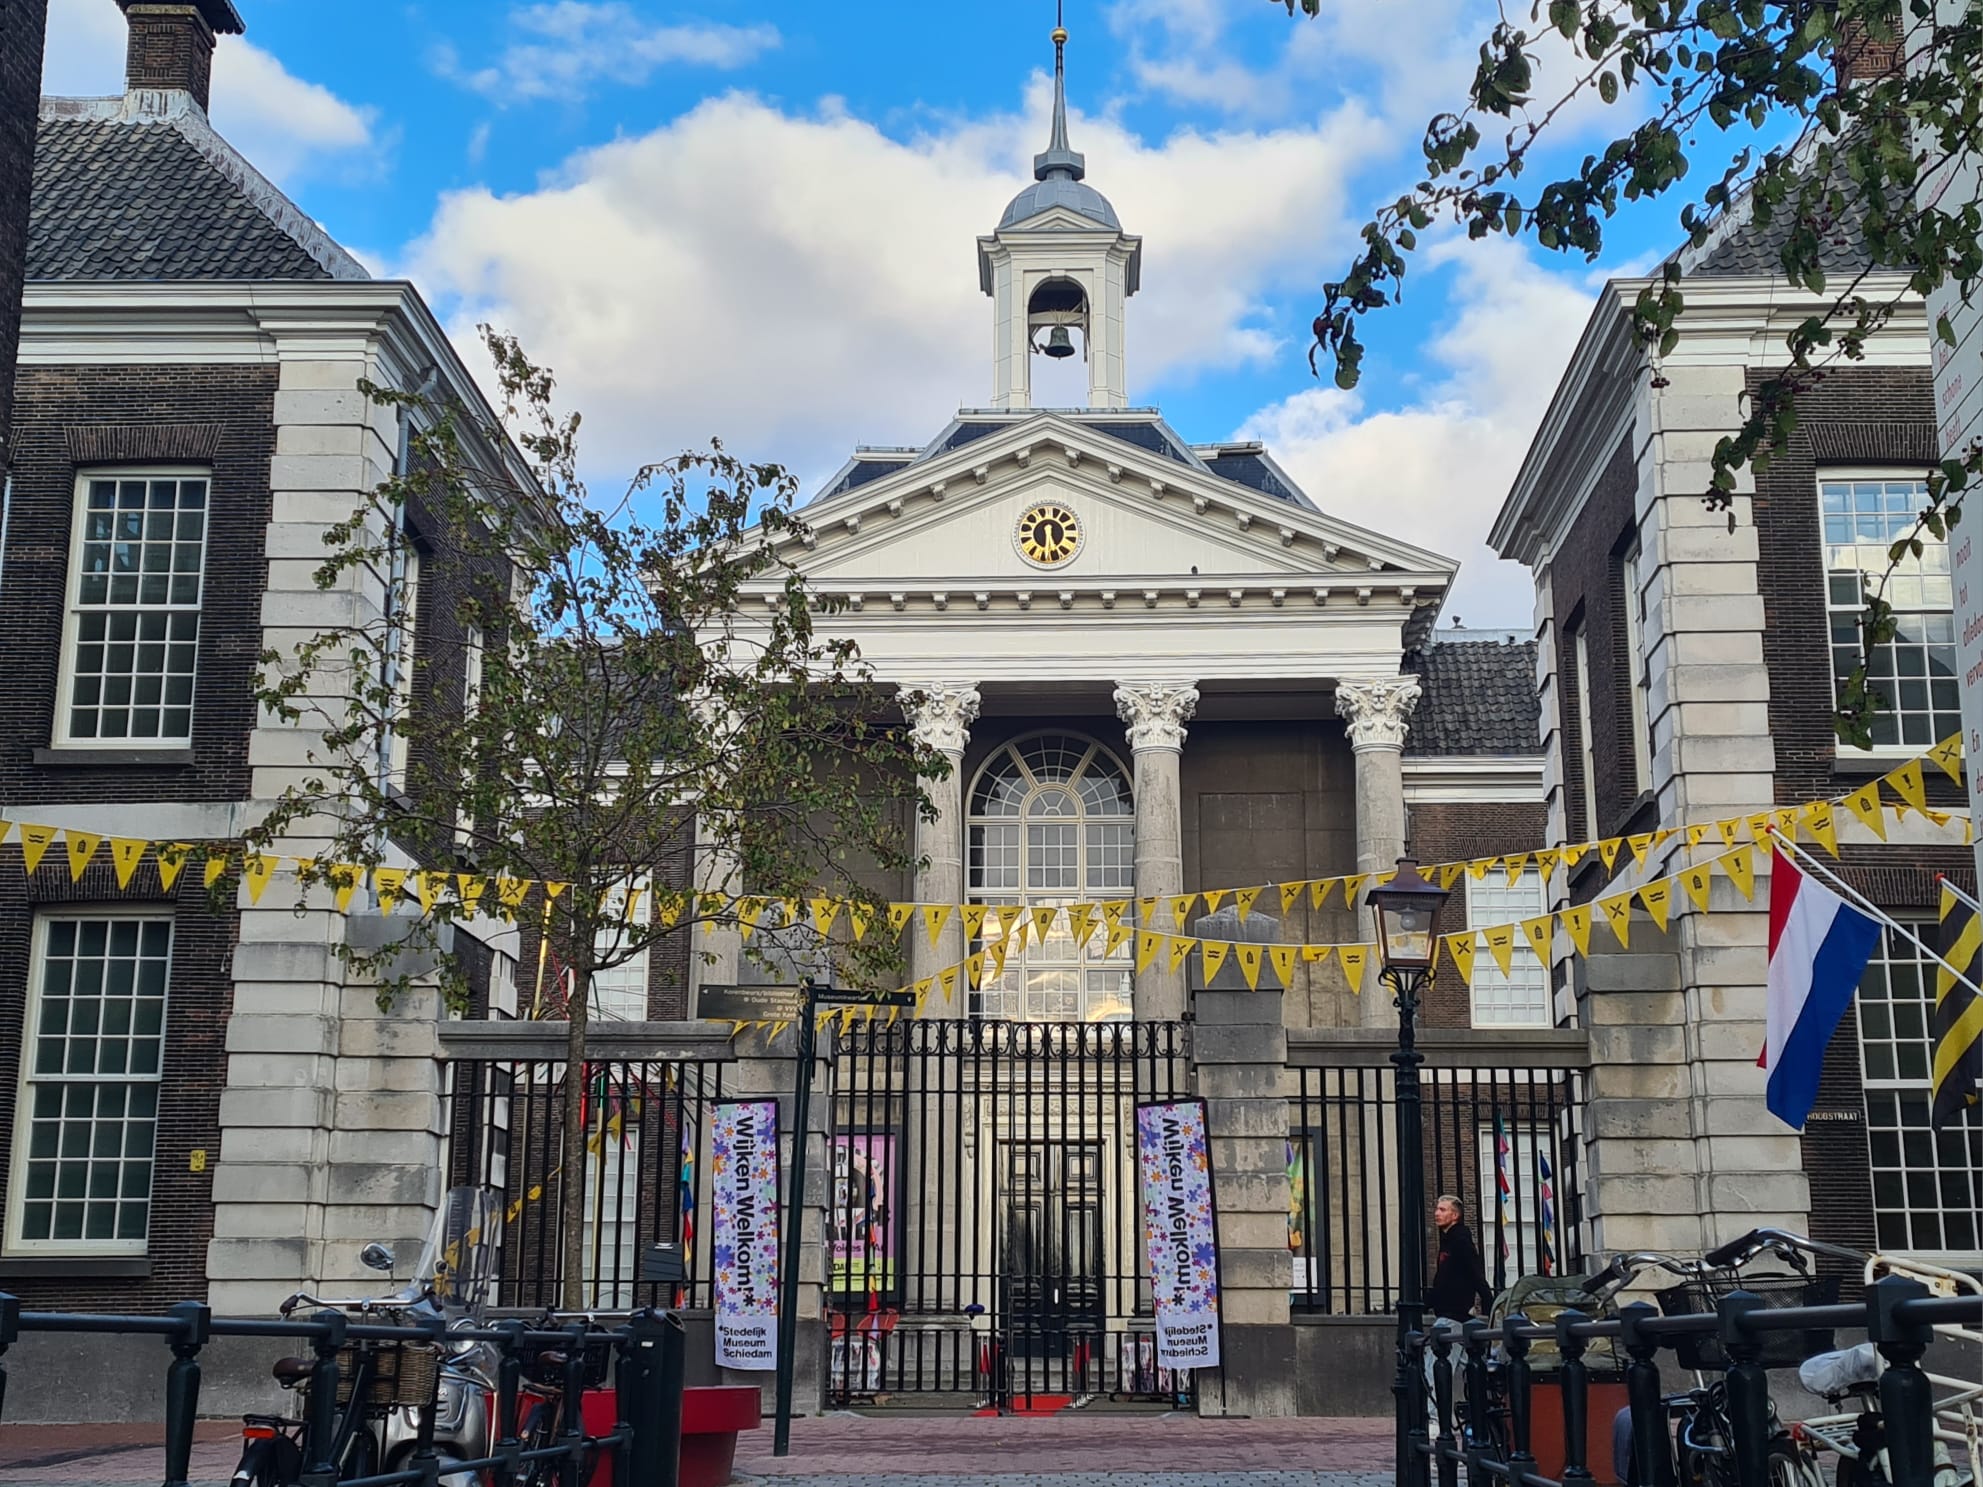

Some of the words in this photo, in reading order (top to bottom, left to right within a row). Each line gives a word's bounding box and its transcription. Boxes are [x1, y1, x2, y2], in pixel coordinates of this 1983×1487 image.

[1807, 1111, 1858, 1121] HOOGSTRAAT
[733, 1116, 756, 1191] Wijken
[723, 1337, 766, 1347] Museum
[723, 1347, 773, 1359] Schiedam
